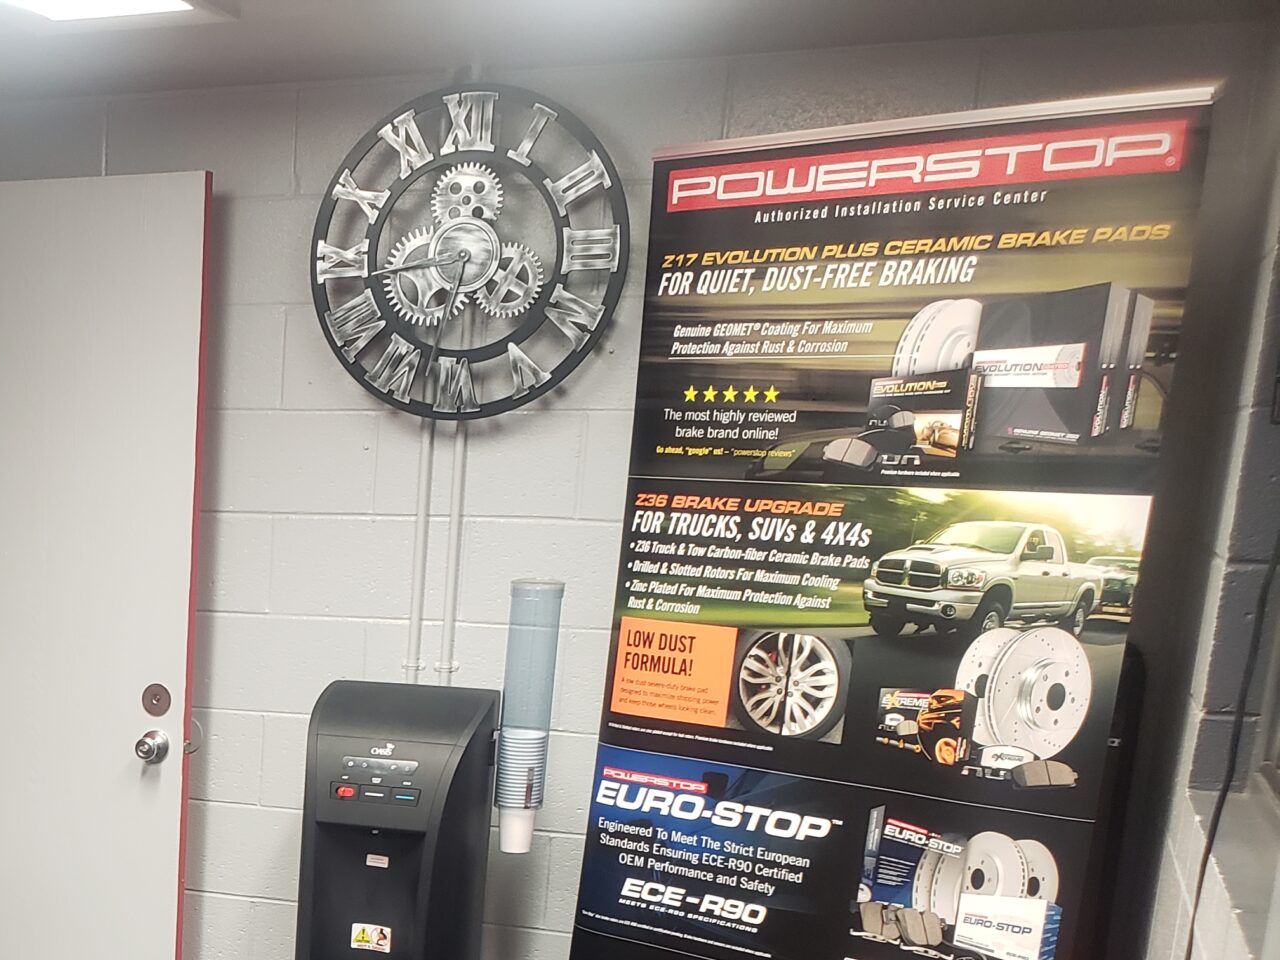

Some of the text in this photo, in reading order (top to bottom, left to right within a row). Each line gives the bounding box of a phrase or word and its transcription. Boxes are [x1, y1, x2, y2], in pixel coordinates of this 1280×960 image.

[754, 190, 1048, 223] Authorized Installation Service Center
[661, 224, 1171, 268] Z17 EVOLUTION PLUS CERAMIC BRAKE PADS
[658, 256, 978, 296] FOR QUIET, DUST-FREE BRAKING
[673, 324, 712, 338] Genuine
[761, 321, 799, 338] Coating
[801, 320, 821, 335] For
[821, 320, 873, 335] Maximum
[671, 339, 848, 356] Protection Against Rust & Corrosion
[974, 362, 1044, 372] EVOLUTION
[873, 380, 936, 394] EVOLUTION
[663, 408, 797, 424] The most highly reviewed
[675, 426, 779, 440] brake brand online!
[635, 493, 845, 517] Z36 BRAKE UPGRADE
[631, 510, 873, 548] FOR TRUCKS, SUVs & 4X4s
[634, 540, 871, 570] Z36 Truck & Tow Carbon-fiber Ceramic Brake Pads
[632, 560, 841, 590] Drilled & Slotted Rotors For Maximum Cooling
[627, 596, 701, 614] Rust & Corrosion
[629, 579, 833, 610] Zinc Plated For Maximum Protection Against
[626, 629, 697, 654] LOW DUST
[624, 652, 694, 677] FORMULA!
[603, 768, 706, 792] POWERSTOP
[598, 817, 810, 868] Engineered To Meet The Strict European
[883, 825, 962, 854] EURO-STOP
[600, 833, 803, 883] Standards Ensuring ECE-R90 Certified
[618, 853, 775, 896] OEM Performance and Safety
[618, 897, 758, 934] MEETS ECE-R90 SPECIFICATIONS
[621, 877, 768, 925] ECE-R90
[962, 916, 1033, 935] EURO-STOP
